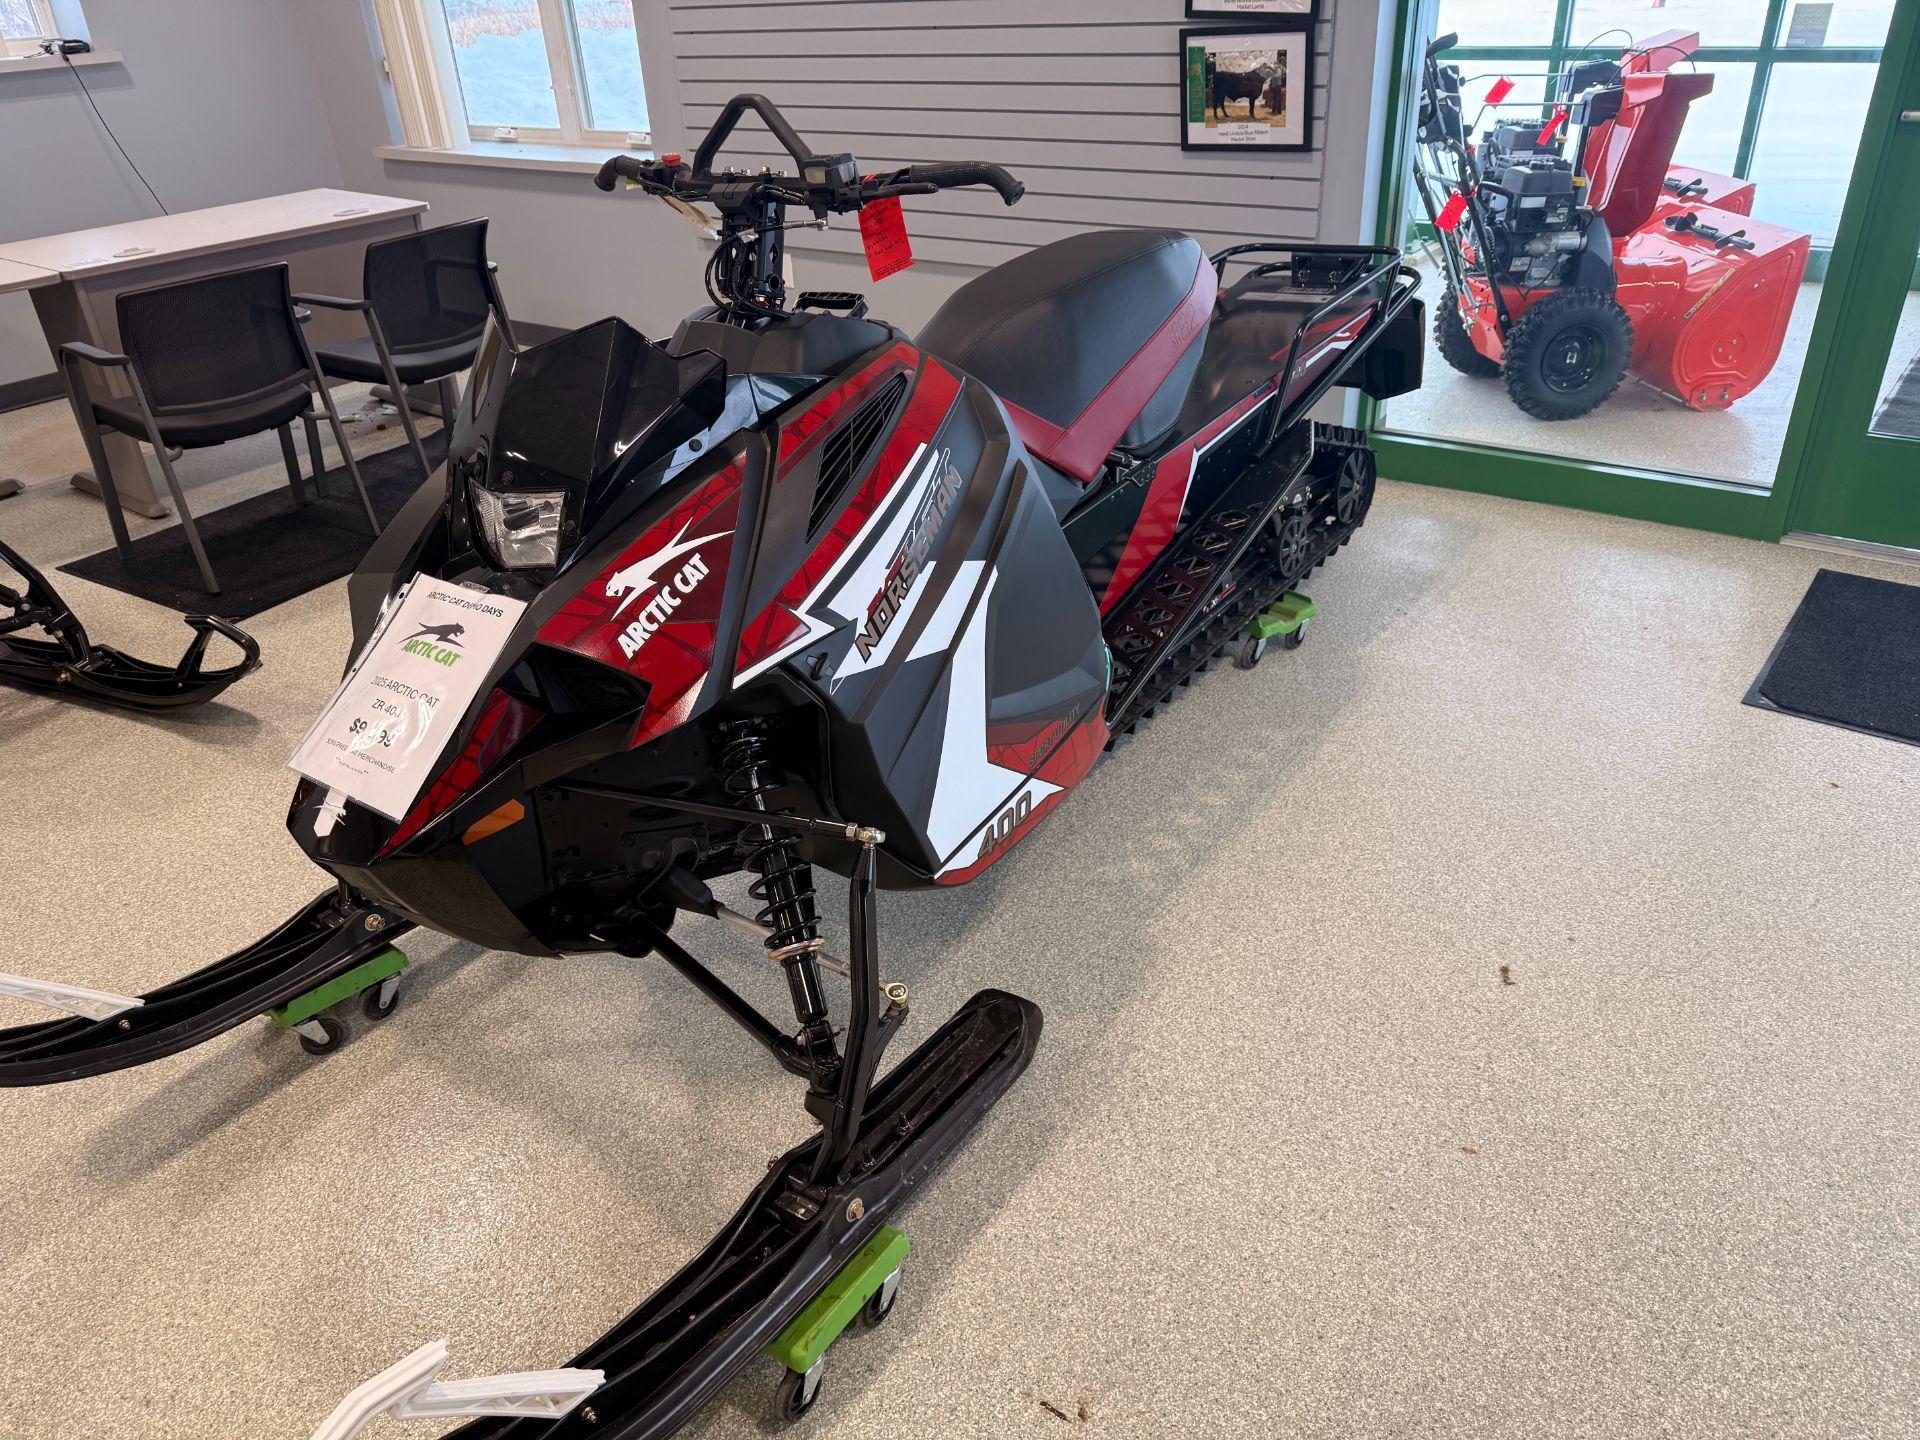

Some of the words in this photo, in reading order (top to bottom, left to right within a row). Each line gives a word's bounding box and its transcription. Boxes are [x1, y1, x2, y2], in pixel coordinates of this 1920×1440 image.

[855, 464, 963, 664] NORSEMAN
[426, 591, 451, 602] ARCTIC
[448, 595, 465, 606] CAT
[481, 604, 504, 618] DAYS
[617, 585, 682, 660] ARCTIC
[673, 552, 710, 593] CAT
[401, 639, 439, 659] ARCTIC
[433, 648, 462, 667] CAT
[371, 698, 386, 711] ZR
[385, 680, 419, 700] ARCTIC
[1028, 734, 1055, 769] SPORT
[1055, 703, 1081, 739] UTILITY
[335, 741, 349, 752] FREE
[358, 752, 396, 774] MERCHANDISE
[978, 790, 1032, 858] 400
